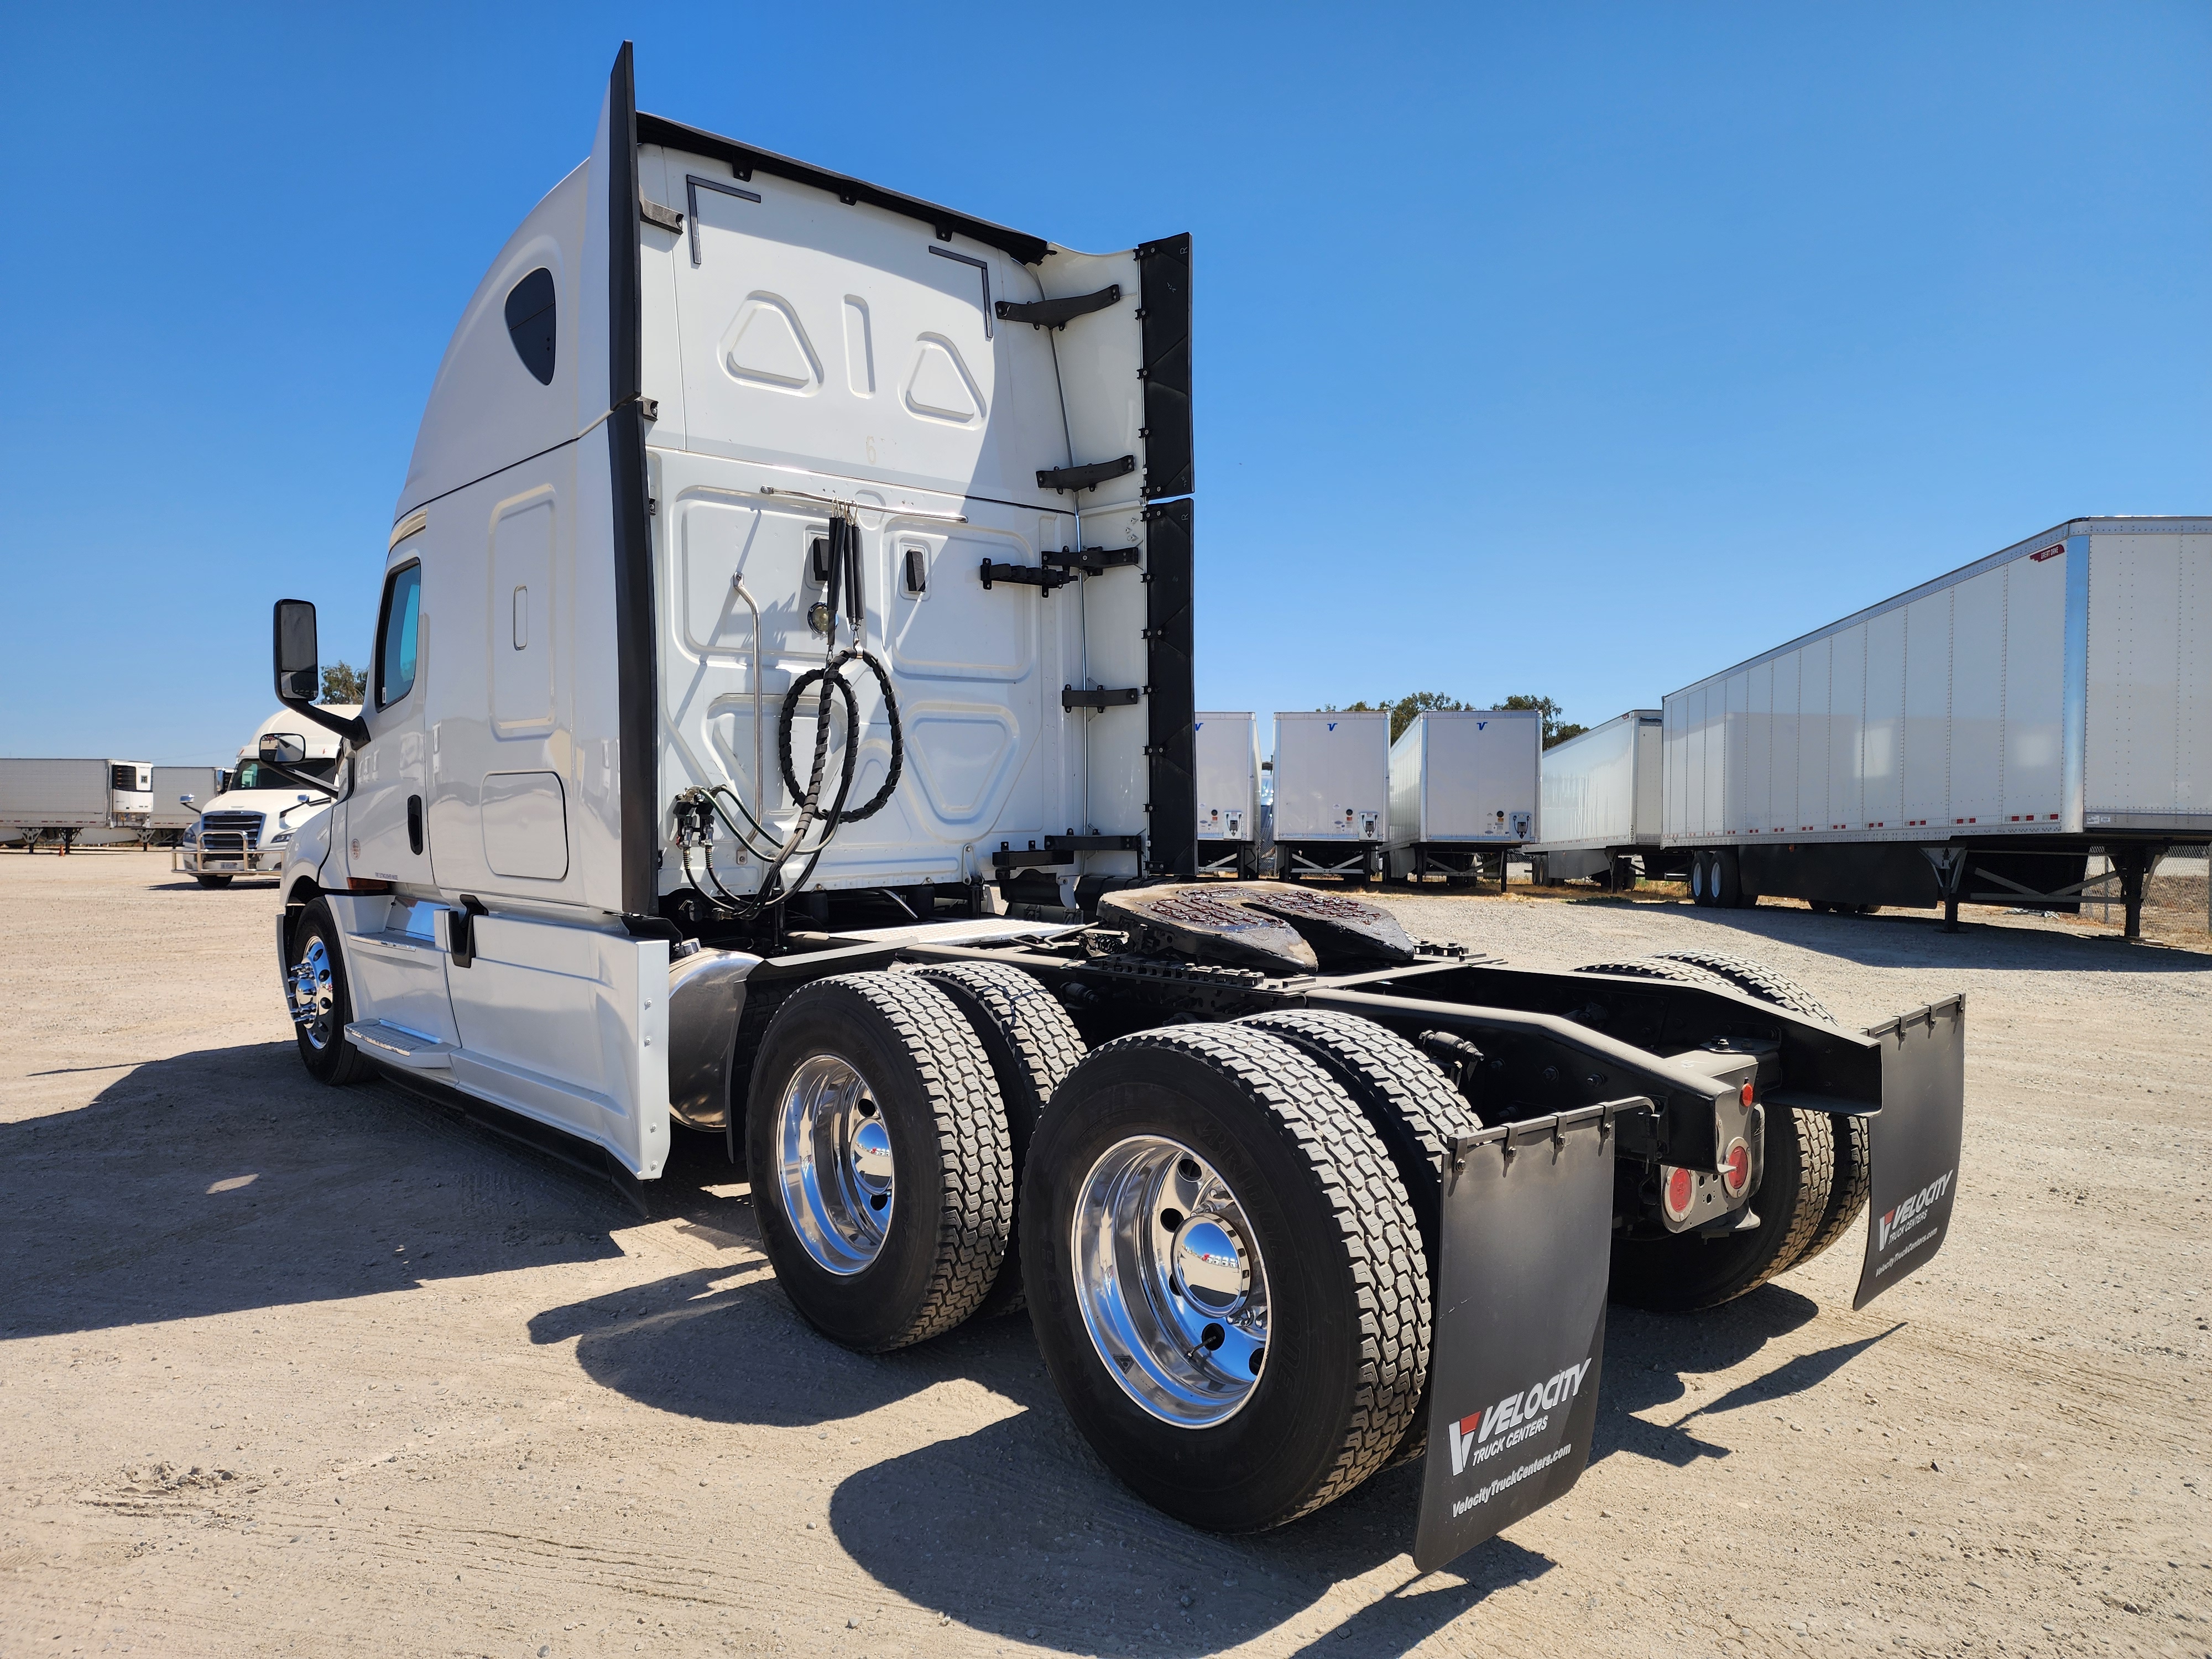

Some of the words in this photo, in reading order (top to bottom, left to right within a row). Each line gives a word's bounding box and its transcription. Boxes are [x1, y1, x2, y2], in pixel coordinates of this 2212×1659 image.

[1888, 1225, 1906, 1245] TRUCK
[1905, 1209, 1928, 1232] CENTERS
[1892, 1169, 1953, 1230] VELOCITY
[1478, 1357, 1592, 1443] VELOCITY
[1472, 1436, 1505, 1467] TRUCK
[1506, 1415, 1548, 1449] CENTERS
[1452, 1443, 1572, 1518] VelocityTruckCenters.com
